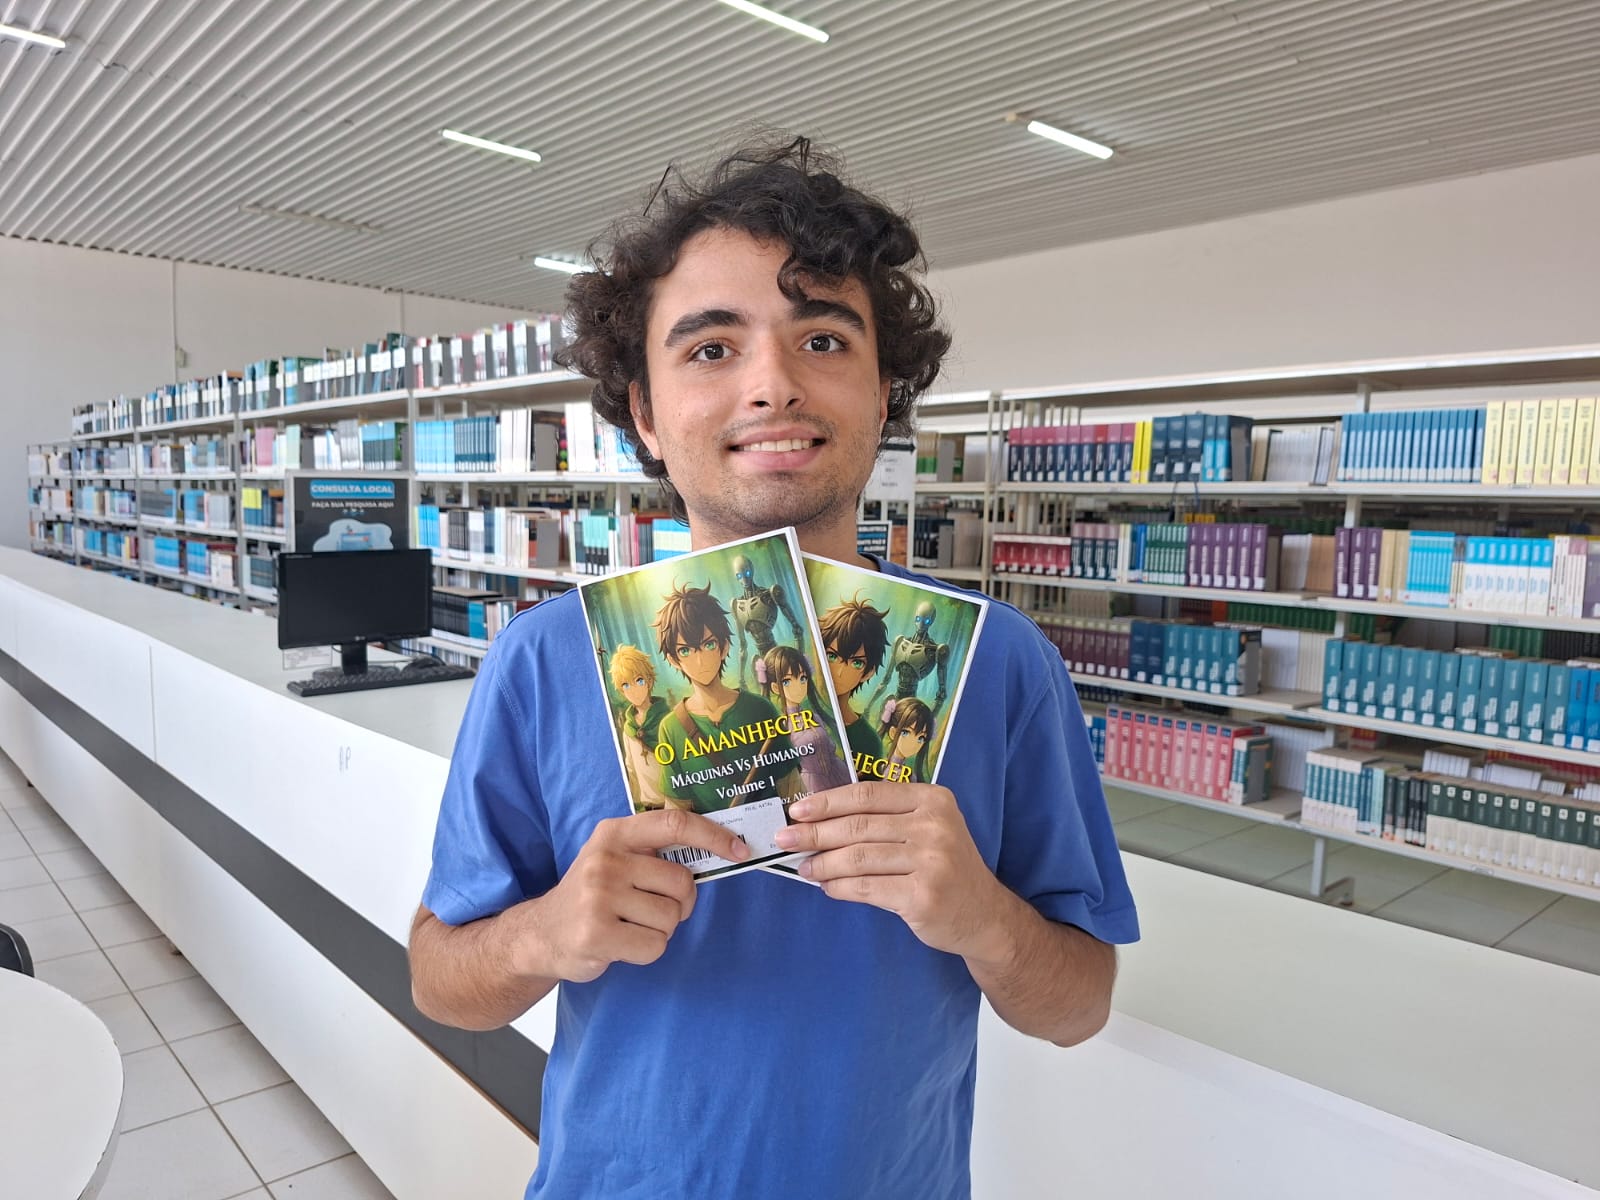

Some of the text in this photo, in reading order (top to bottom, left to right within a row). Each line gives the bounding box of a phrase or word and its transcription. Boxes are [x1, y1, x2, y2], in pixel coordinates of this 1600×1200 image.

[311, 485, 393, 494] CONSULTA LOCAL
[655, 709, 819, 766] O AMANHECER
[670, 763, 735, 789] MÁQUINAS
[752, 743, 815, 768] HUMANOS
[853, 752, 912, 783] HECER
[716, 775, 776, 800] Volume 1
